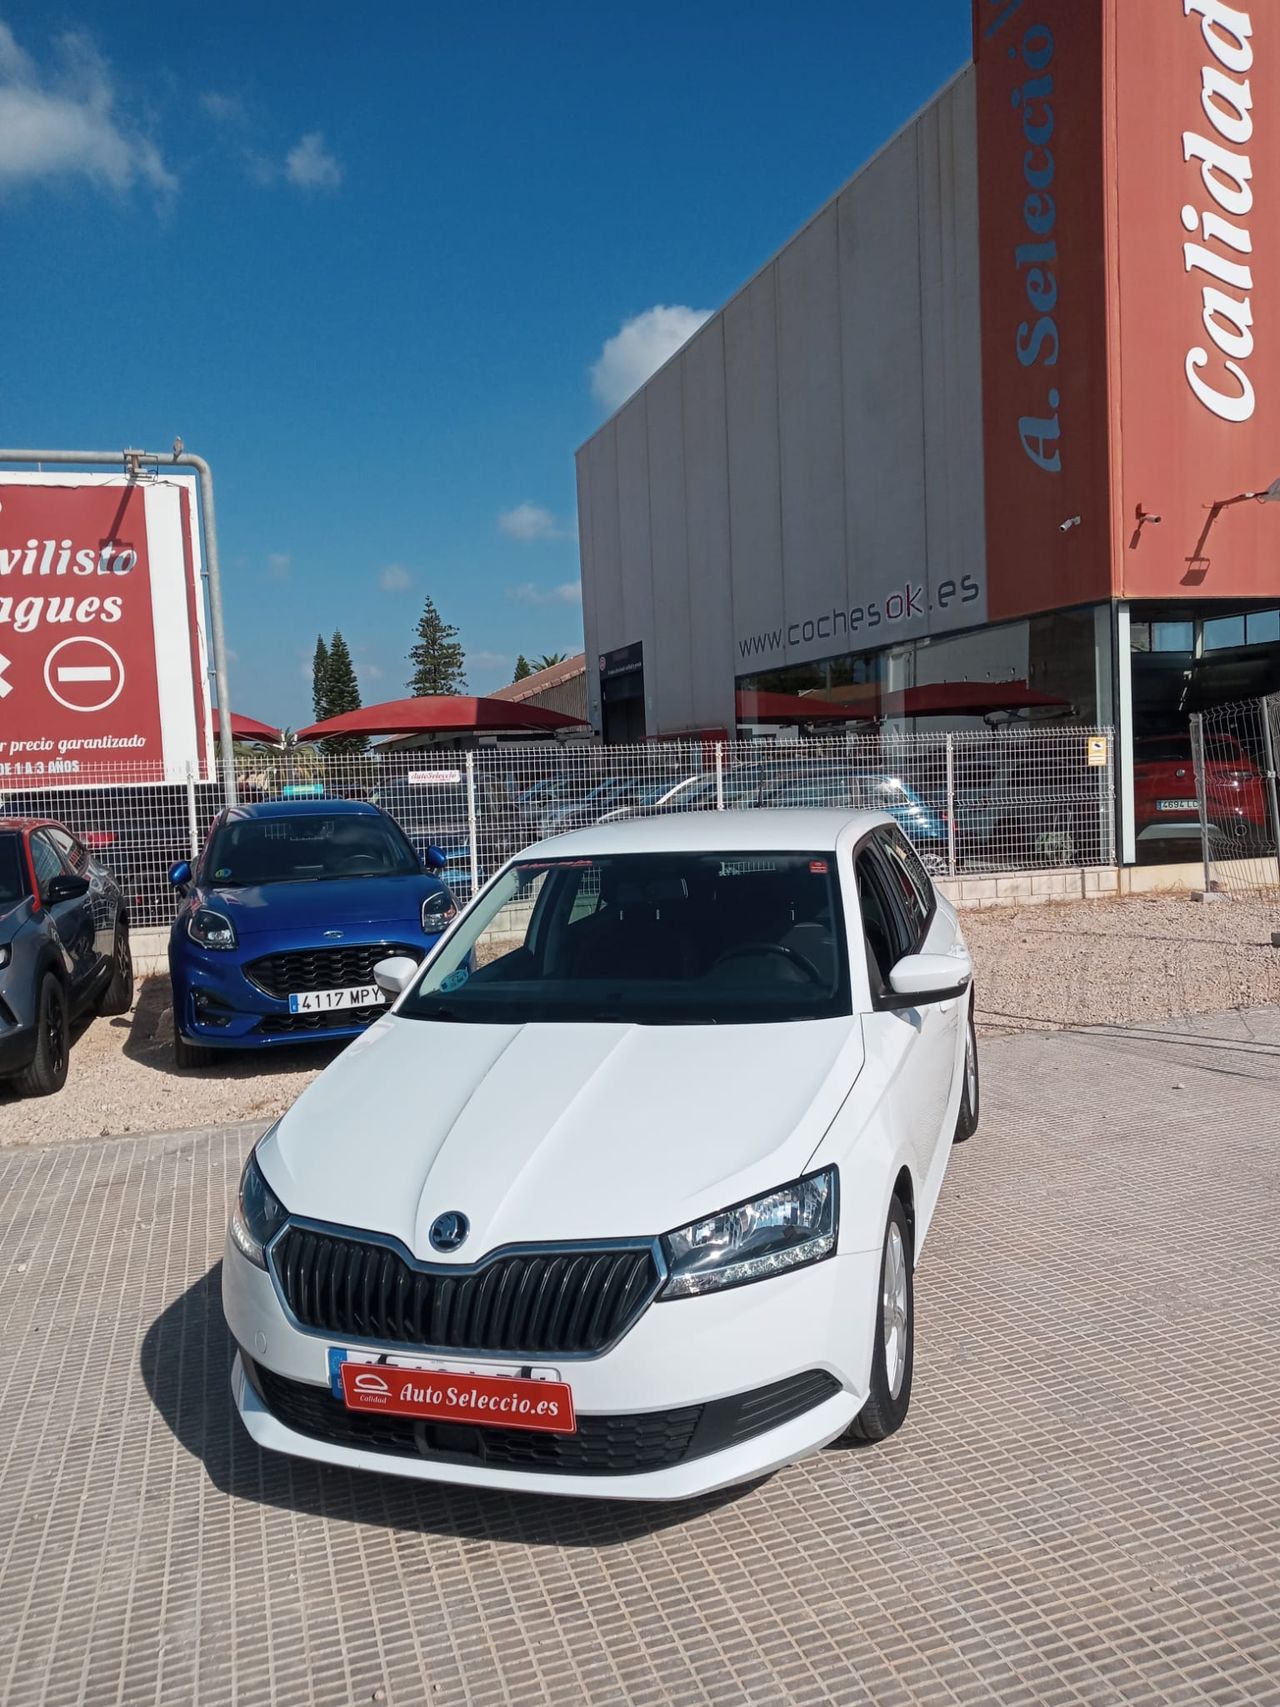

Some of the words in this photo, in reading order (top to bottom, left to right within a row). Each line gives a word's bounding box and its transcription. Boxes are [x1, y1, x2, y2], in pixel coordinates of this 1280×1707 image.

[1181, 0, 1255, 423] Calidad
[1018, 387, 1062, 473] A.
[739, 574, 980, 658] www.cochesok.es
[10, 737, 55, 756] precio
[58, 734, 147, 755] garantizado
[15, 761, 22, 775] 1
[25, 761, 34, 775] A
[36, 761, 45, 774] 3
[48, 757, 80, 774] AÑOS
[302, 992, 344, 1009] 4117
[350, 987, 380, 1004] MPY
[360, 1394, 387, 1404] Calidad
